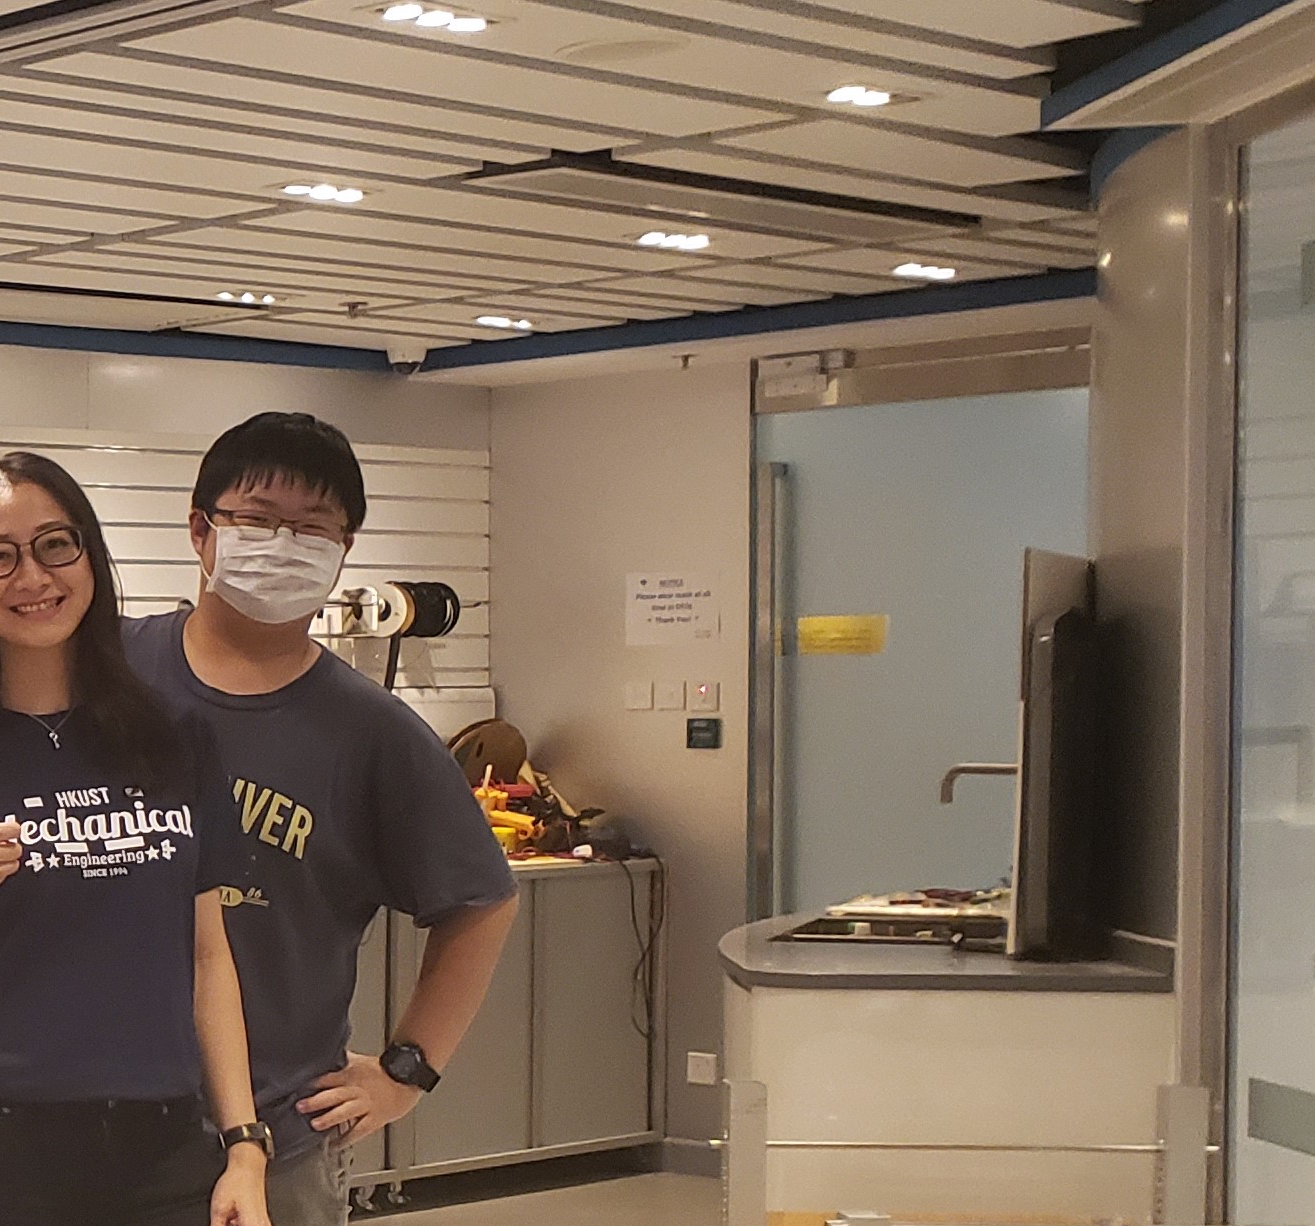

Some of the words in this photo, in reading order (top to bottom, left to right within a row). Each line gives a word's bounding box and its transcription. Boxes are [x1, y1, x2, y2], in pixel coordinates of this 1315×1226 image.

[55, 787, 111, 808] HKUST
[233, 778, 314, 860] VER
[63, 850, 146, 870] Engineering
